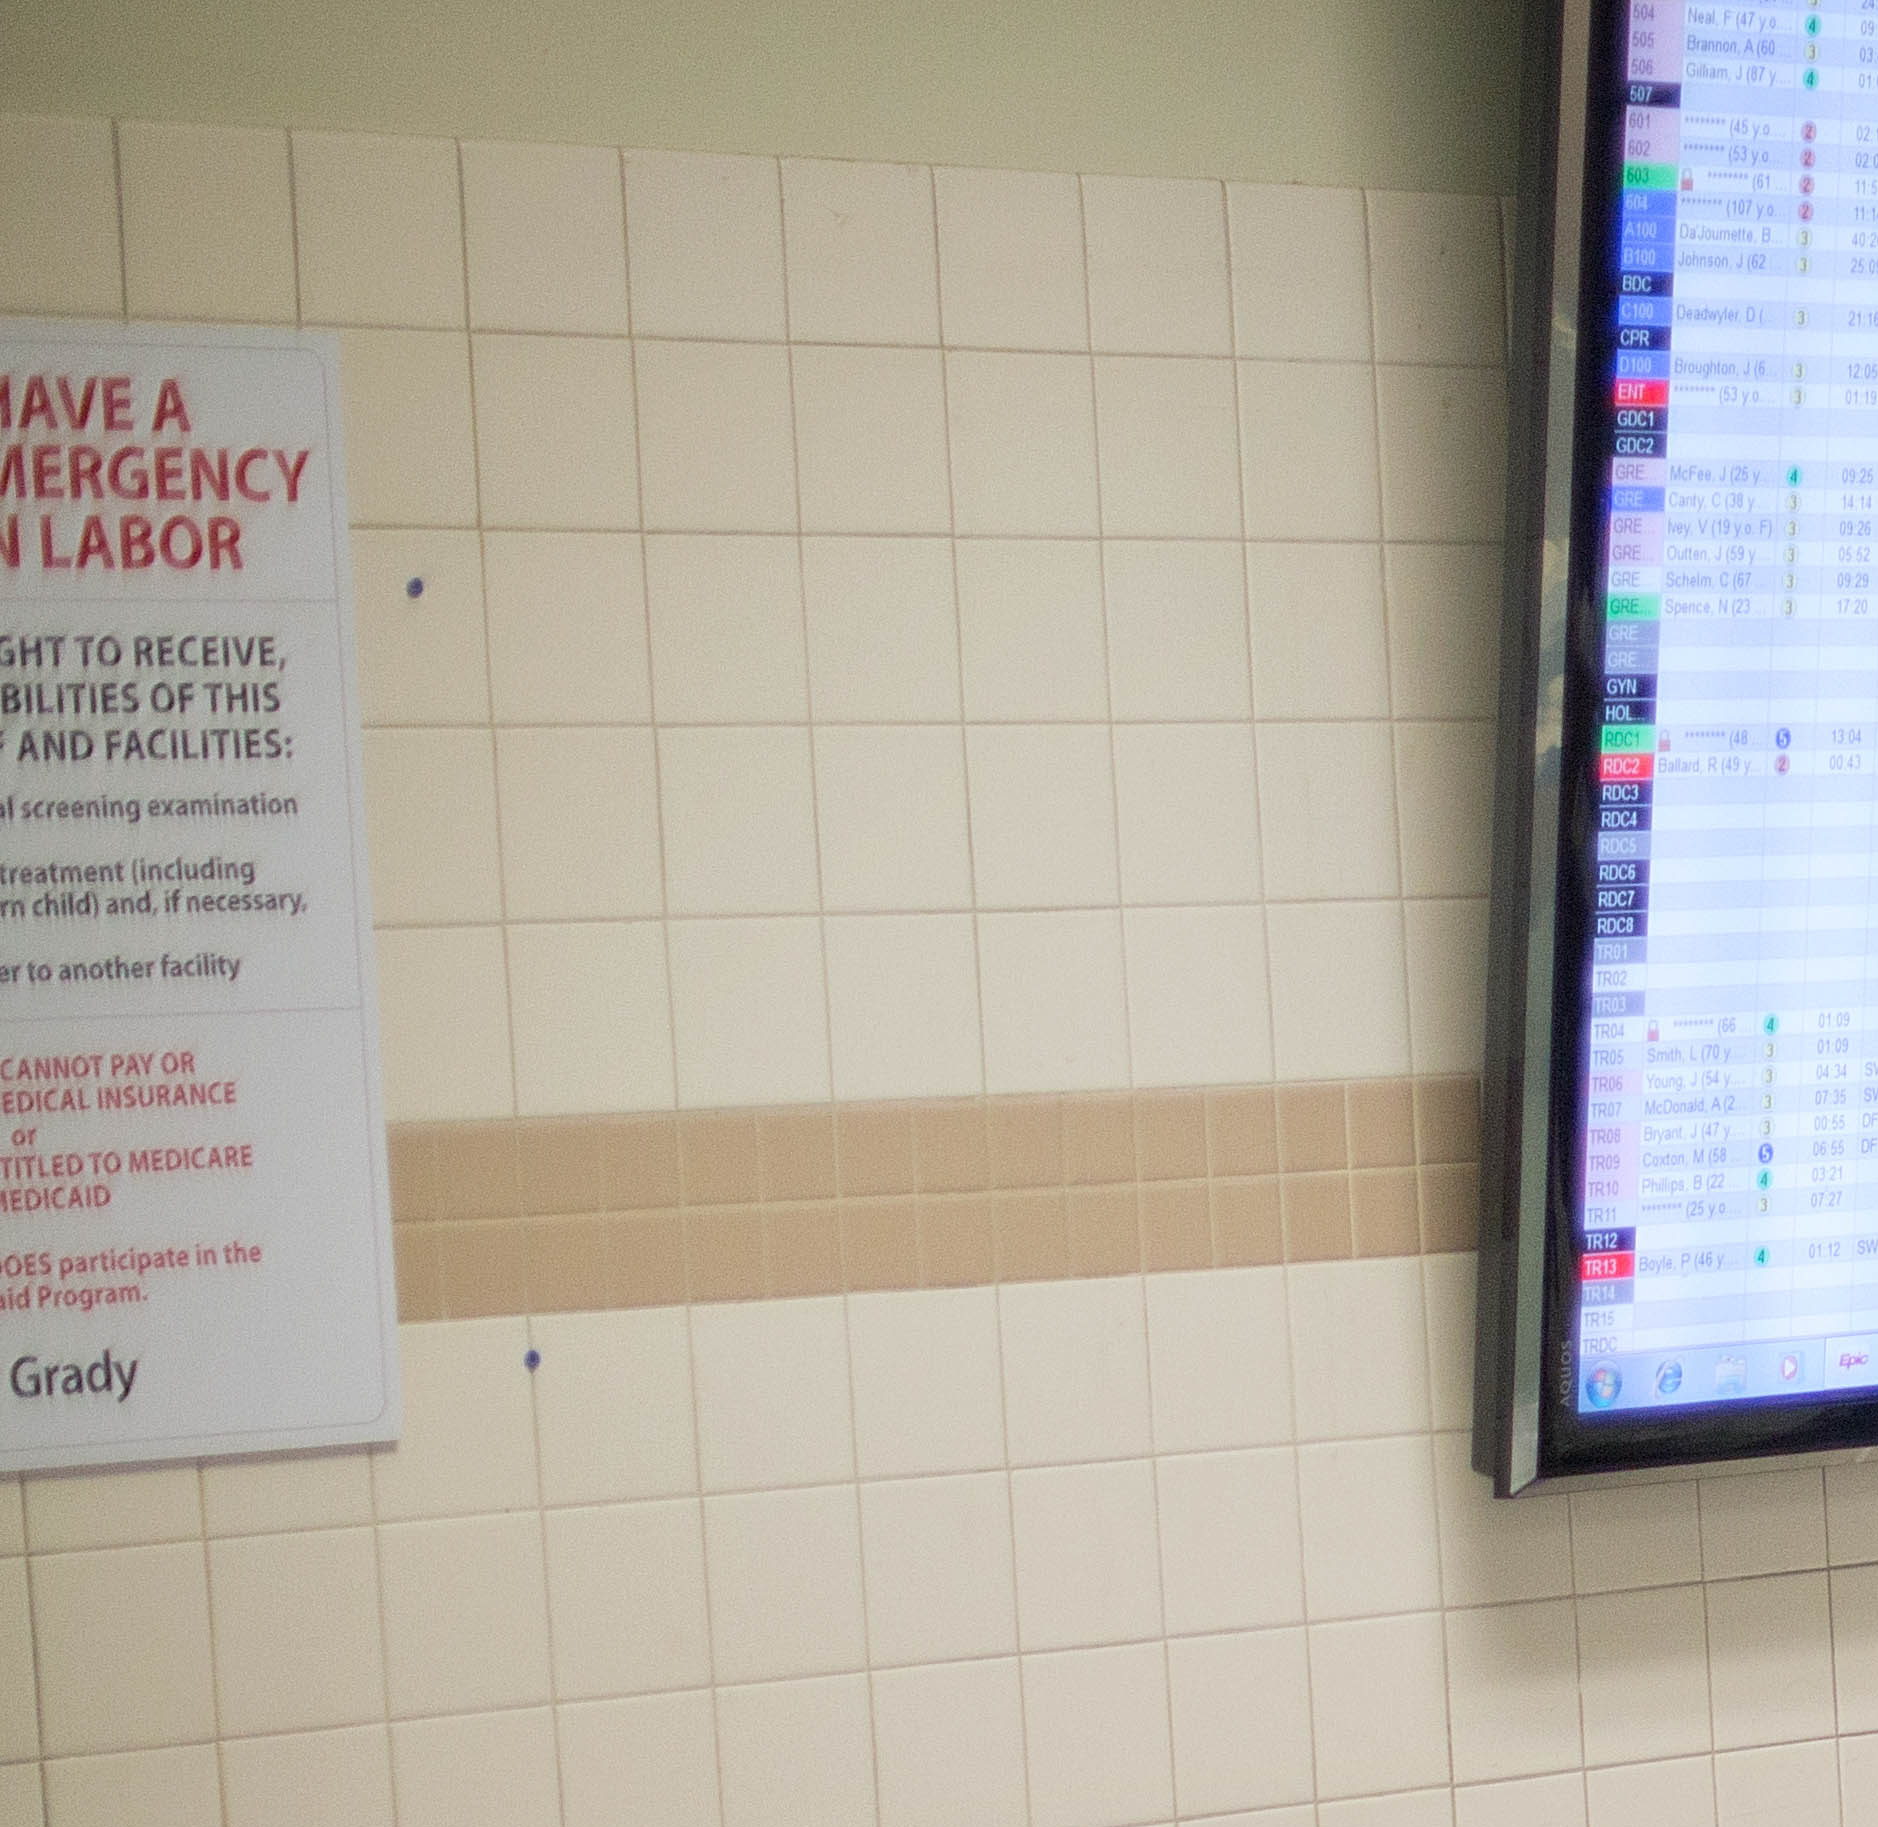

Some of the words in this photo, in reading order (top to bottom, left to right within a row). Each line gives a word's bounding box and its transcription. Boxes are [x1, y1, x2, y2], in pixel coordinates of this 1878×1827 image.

[1620, 330, 1650, 346] CPR
[1618, 383, 1645, 400] ENT
[152, 377, 191, 432] A
[1617, 410, 1654, 427] GDC1
[1616, 438, 1654, 454] GDC2
[40, 514, 243, 570] LABOR
[75, 636, 122, 667] TO
[133, 636, 286, 671] RECEIVE,
[1606, 678, 1638, 695] GYN
[1, 682, 139, 714] BILITIES
[151, 682, 194, 714] OF
[205, 682, 281, 713] THIS
[17, 729, 94, 762] AND
[105, 728, 293, 761] FACILITIES:
[1604, 732, 1640, 748] RDC1
[1603, 759, 1640, 775] RDC2
[1602, 785, 1639, 801] RDC3
[20, 794, 140, 823] screening
[148, 792, 298, 818] examination
[1601, 811, 1638, 828] RDC4
[0, 861, 124, 885] treatment
[131, 855, 256, 886] (including
[1599, 864, 1636, 881] RDC6
[32, 890, 100, 919] child)
[106, 890, 157, 917] and,
[164, 888, 184, 914] if
[187, 892, 307, 917] necessary,
[1598, 890, 1635, 907] RDC7
[1597, 917, 1634, 934] RDC8
[28, 961, 51, 983] to
[59, 956, 154, 981] another
[161, 952, 242, 982] facility
[1593, 1023, 1625, 1039] TR04
[1, 1055, 103, 1081] CANNOT
[110, 1053, 154, 1078] PAY
[160, 1050, 196, 1075] OR
[2, 1087, 91, 1114] EDICAL
[97, 1081, 238, 1110] INSURANCE
[1591, 1102, 1622, 1119] TR07
[10, 1128, 37, 1147] or
[0, 1153, 84, 1180] TITLED
[88, 1151, 122, 1175] TO
[129, 1145, 254, 1174] MEDICARE
[1585, 1232, 1617, 1250] TR12
[59, 1247, 190, 1280] participate
[196, 1244, 218, 1266] in
[223, 1240, 263, 1265] the
[1584, 1259, 1617, 1276] TR13
[38, 1284, 149, 1312] Program.
[1839, 1351, 1869, 1369] Epic
[10, 1348, 138, 1403] Grady
